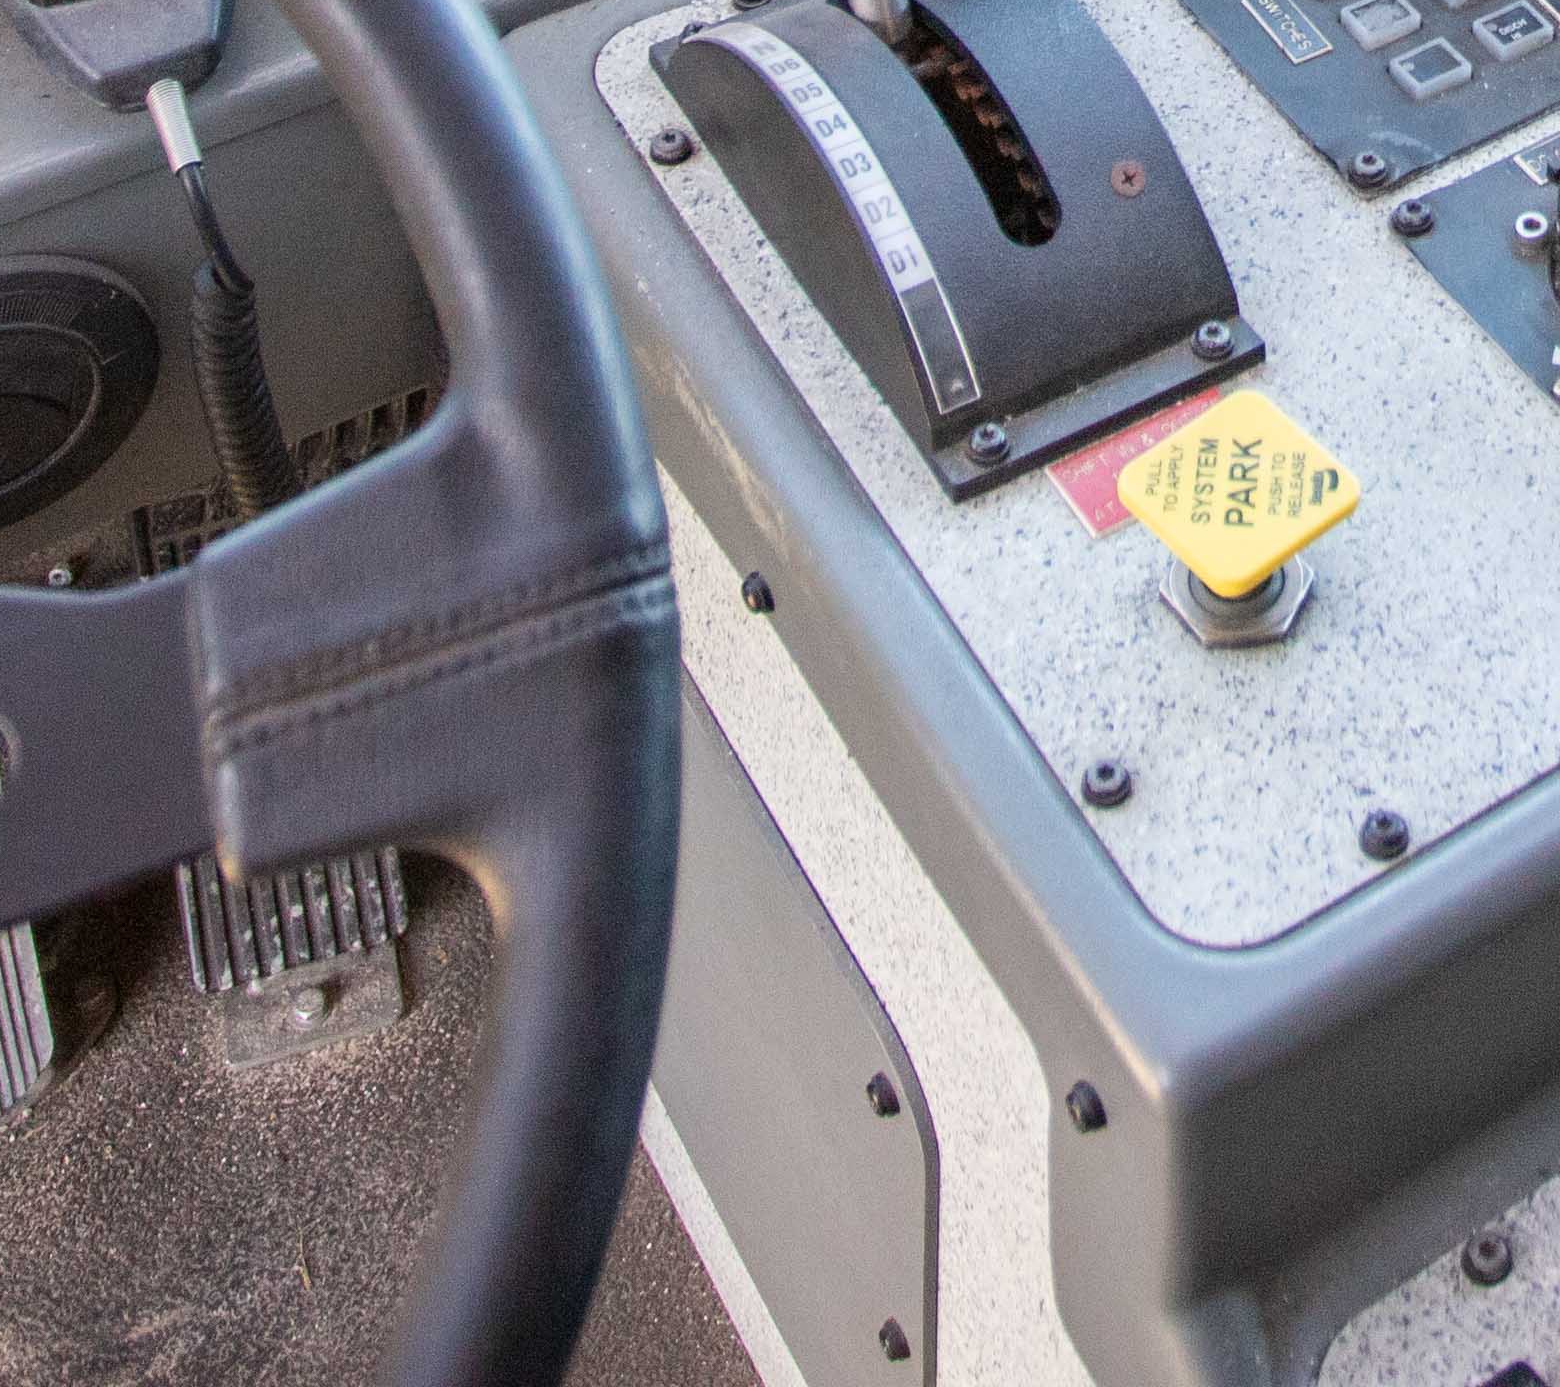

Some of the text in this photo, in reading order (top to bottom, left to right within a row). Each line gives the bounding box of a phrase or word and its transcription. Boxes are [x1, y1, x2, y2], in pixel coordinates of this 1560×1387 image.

[768, 53, 801, 77] D6
[791, 80, 825, 104] D5
[815, 113, 847, 140] D4
[839, 151, 873, 180] D3
[862, 194, 897, 225] D2
[886, 242, 919, 275] D1
[1146, 459, 1163, 497] PULL
[1163, 444, 1184, 512] TO APPLY
[1191, 437, 1220, 525] SYSTEM
[1224, 437, 1263, 527] PARK
[1268, 452, 1287, 516] PUSH TO
[1288, 452, 1306, 517] RELEASE
